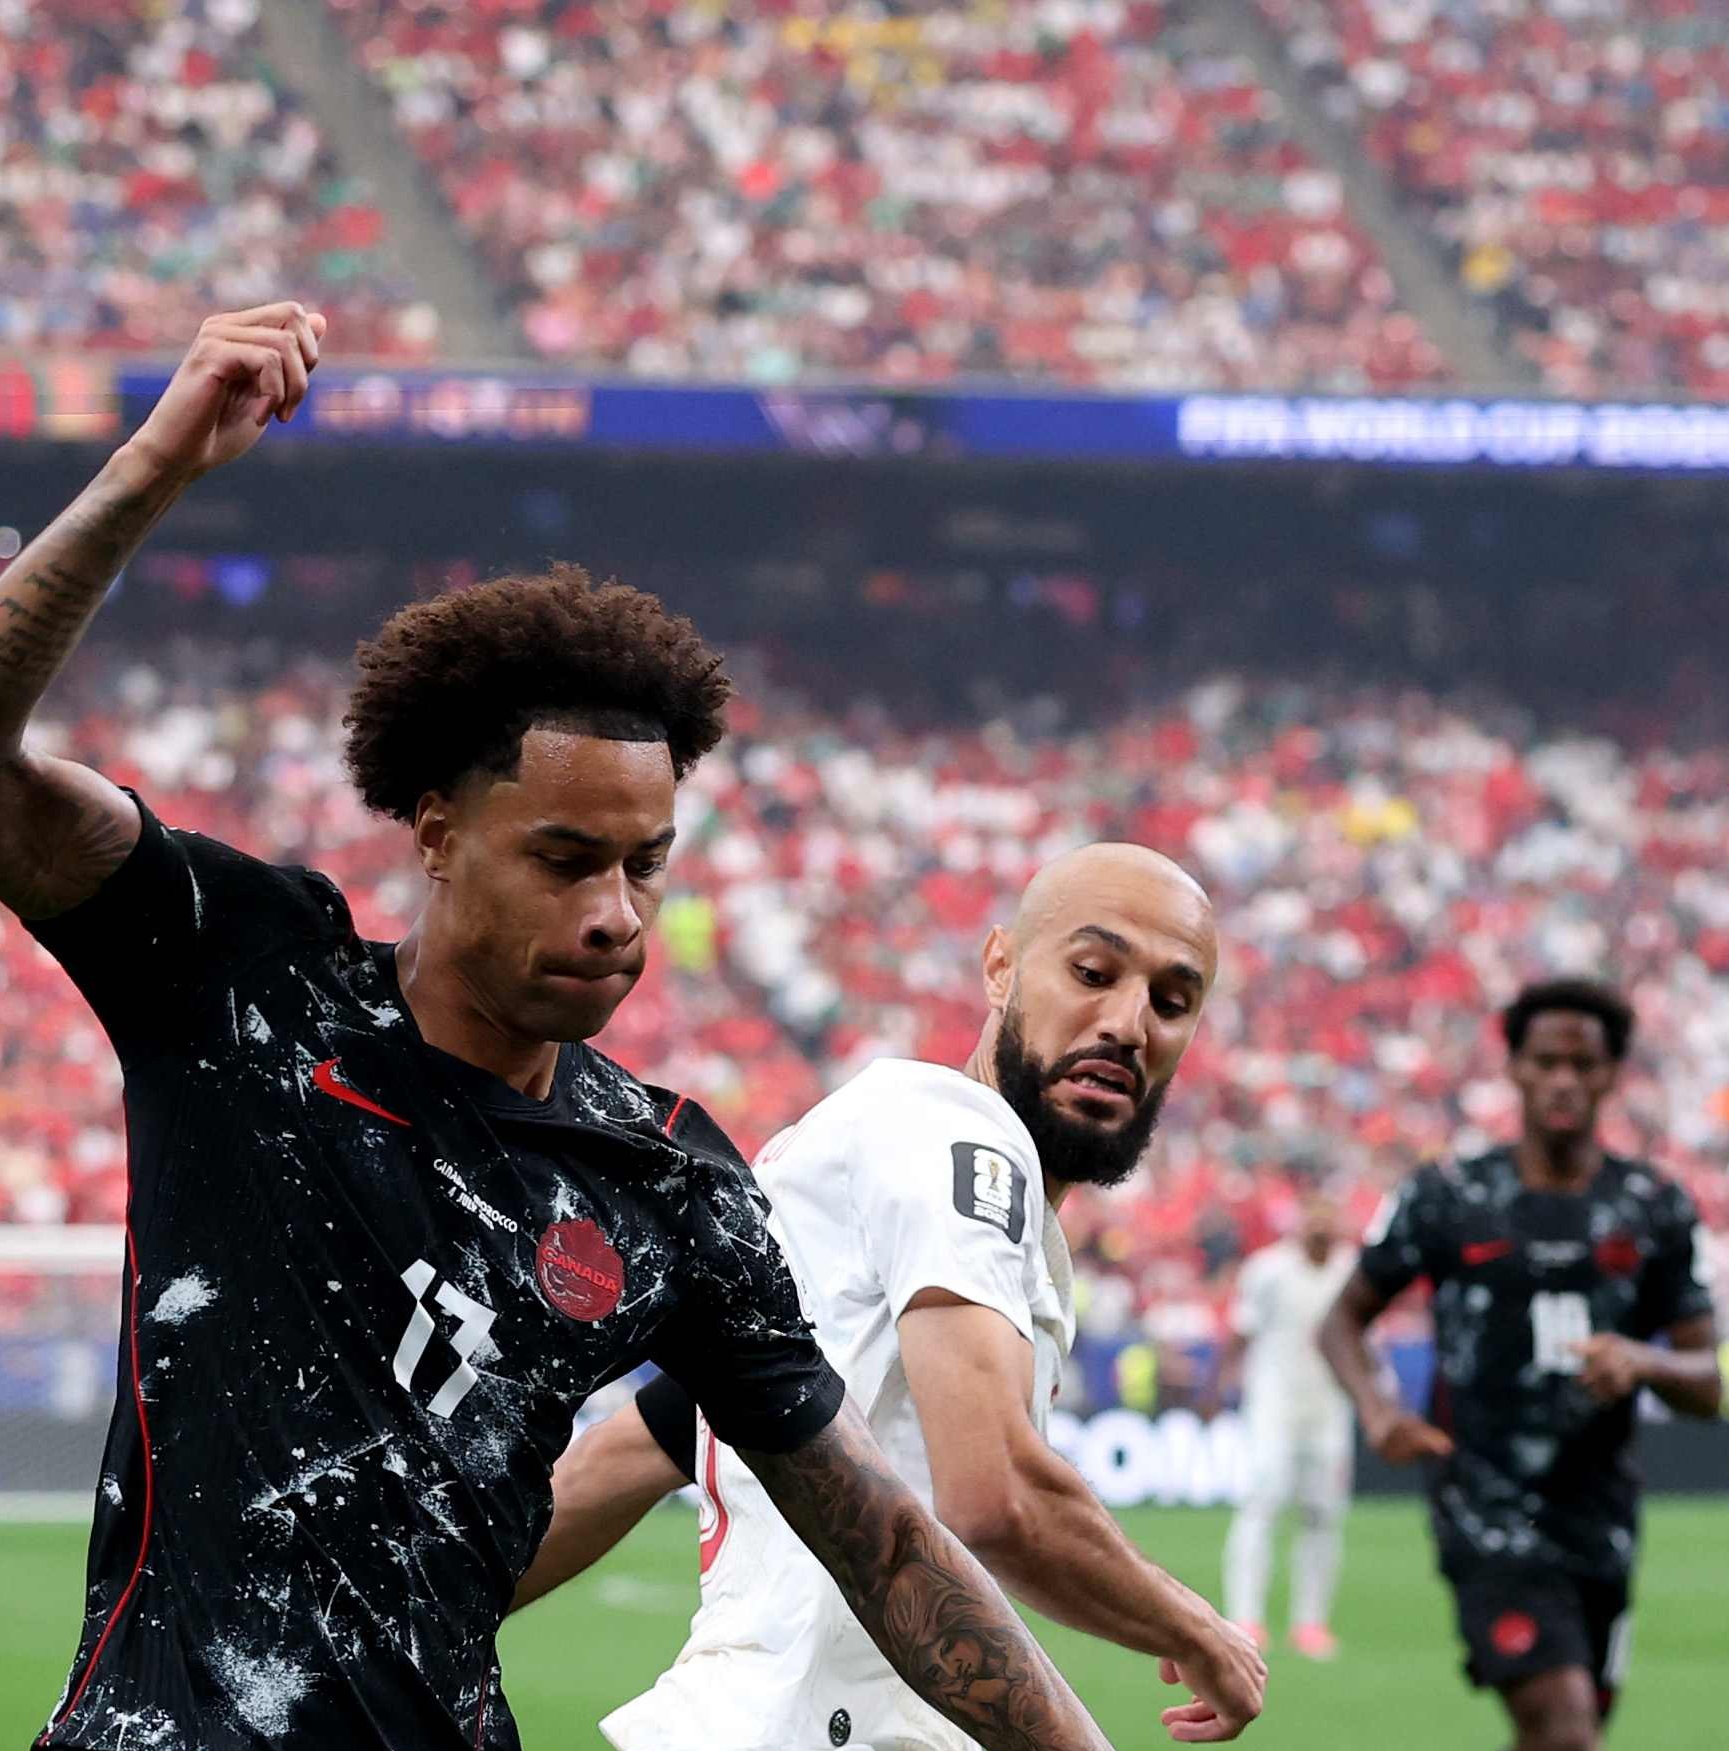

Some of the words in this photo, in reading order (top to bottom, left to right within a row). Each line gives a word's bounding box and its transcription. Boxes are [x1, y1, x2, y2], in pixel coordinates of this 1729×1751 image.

[456, 1192, 478, 1214] JULY
[472, 1194, 519, 1233] MOROCCO
[542, 1246, 619, 1295] CANADA
[391, 1257, 498, 1420] 17
